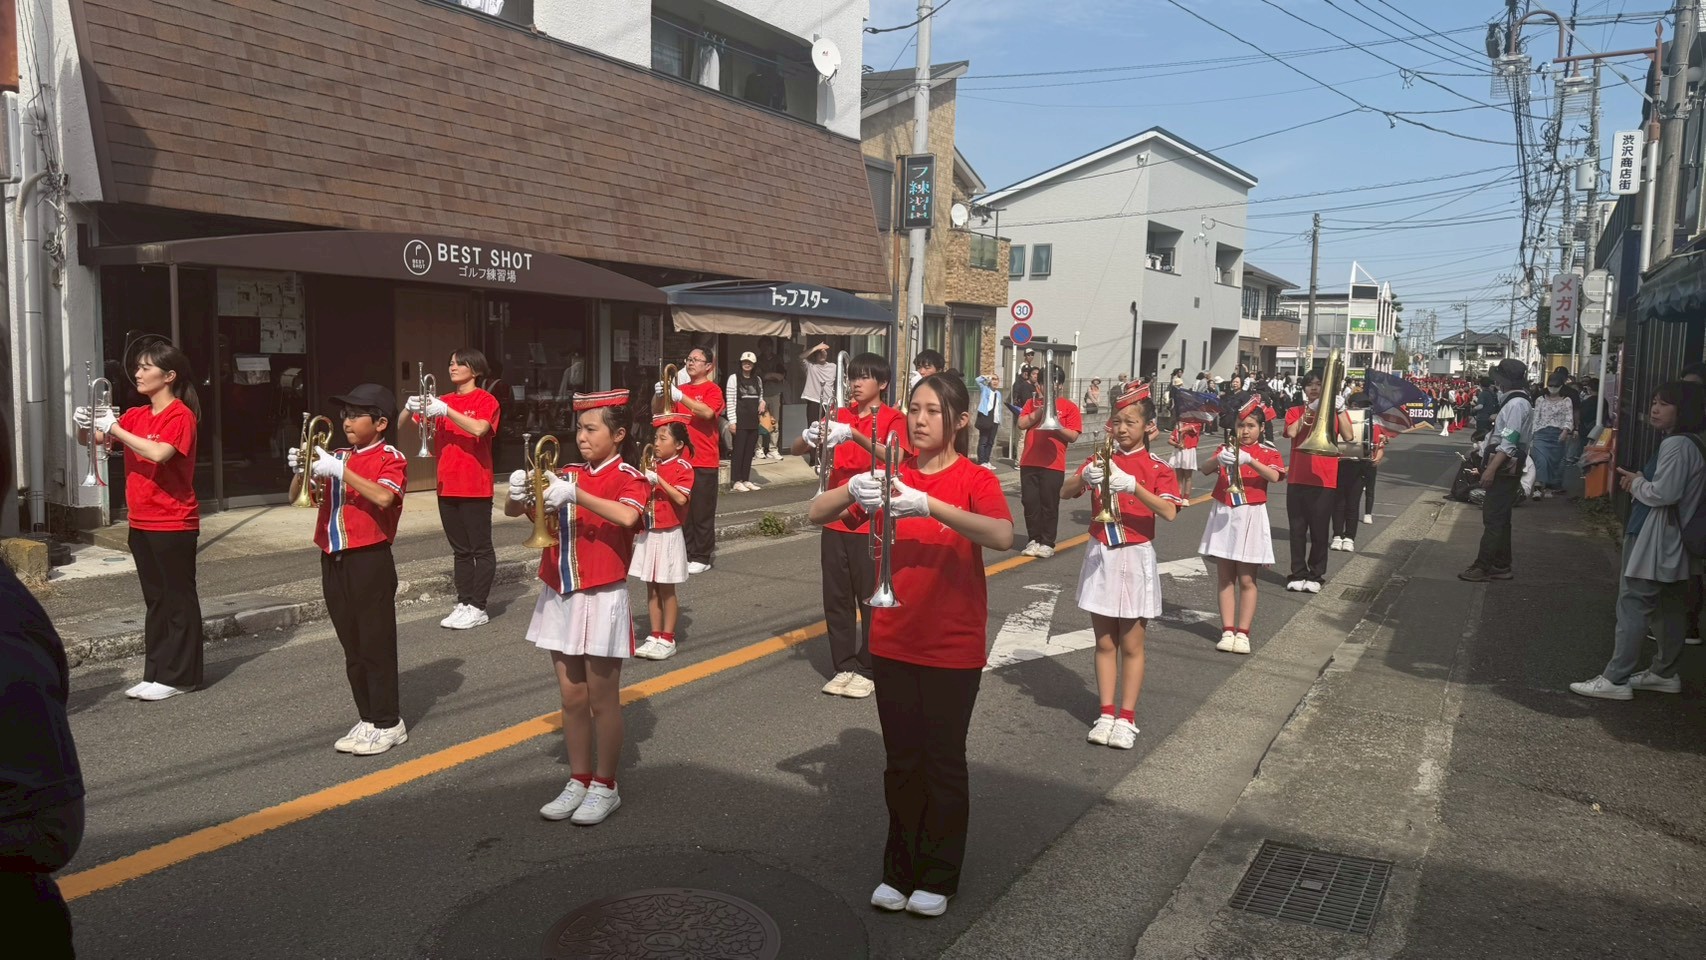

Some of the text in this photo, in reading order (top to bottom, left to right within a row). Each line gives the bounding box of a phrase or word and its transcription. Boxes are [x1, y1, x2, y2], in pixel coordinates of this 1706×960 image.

[1619, 134, 1635, 190] 渋沢商店街
[437, 243, 533, 270] BEST SHOT
[458, 266, 517, 283] ゴルフ練習場
[769, 286, 829, 309] トップスター
[1554, 278, 1573, 332] メガネ
[1015, 305, 1029, 316] 30
[1408, 408, 1434, 419] BIRDS
